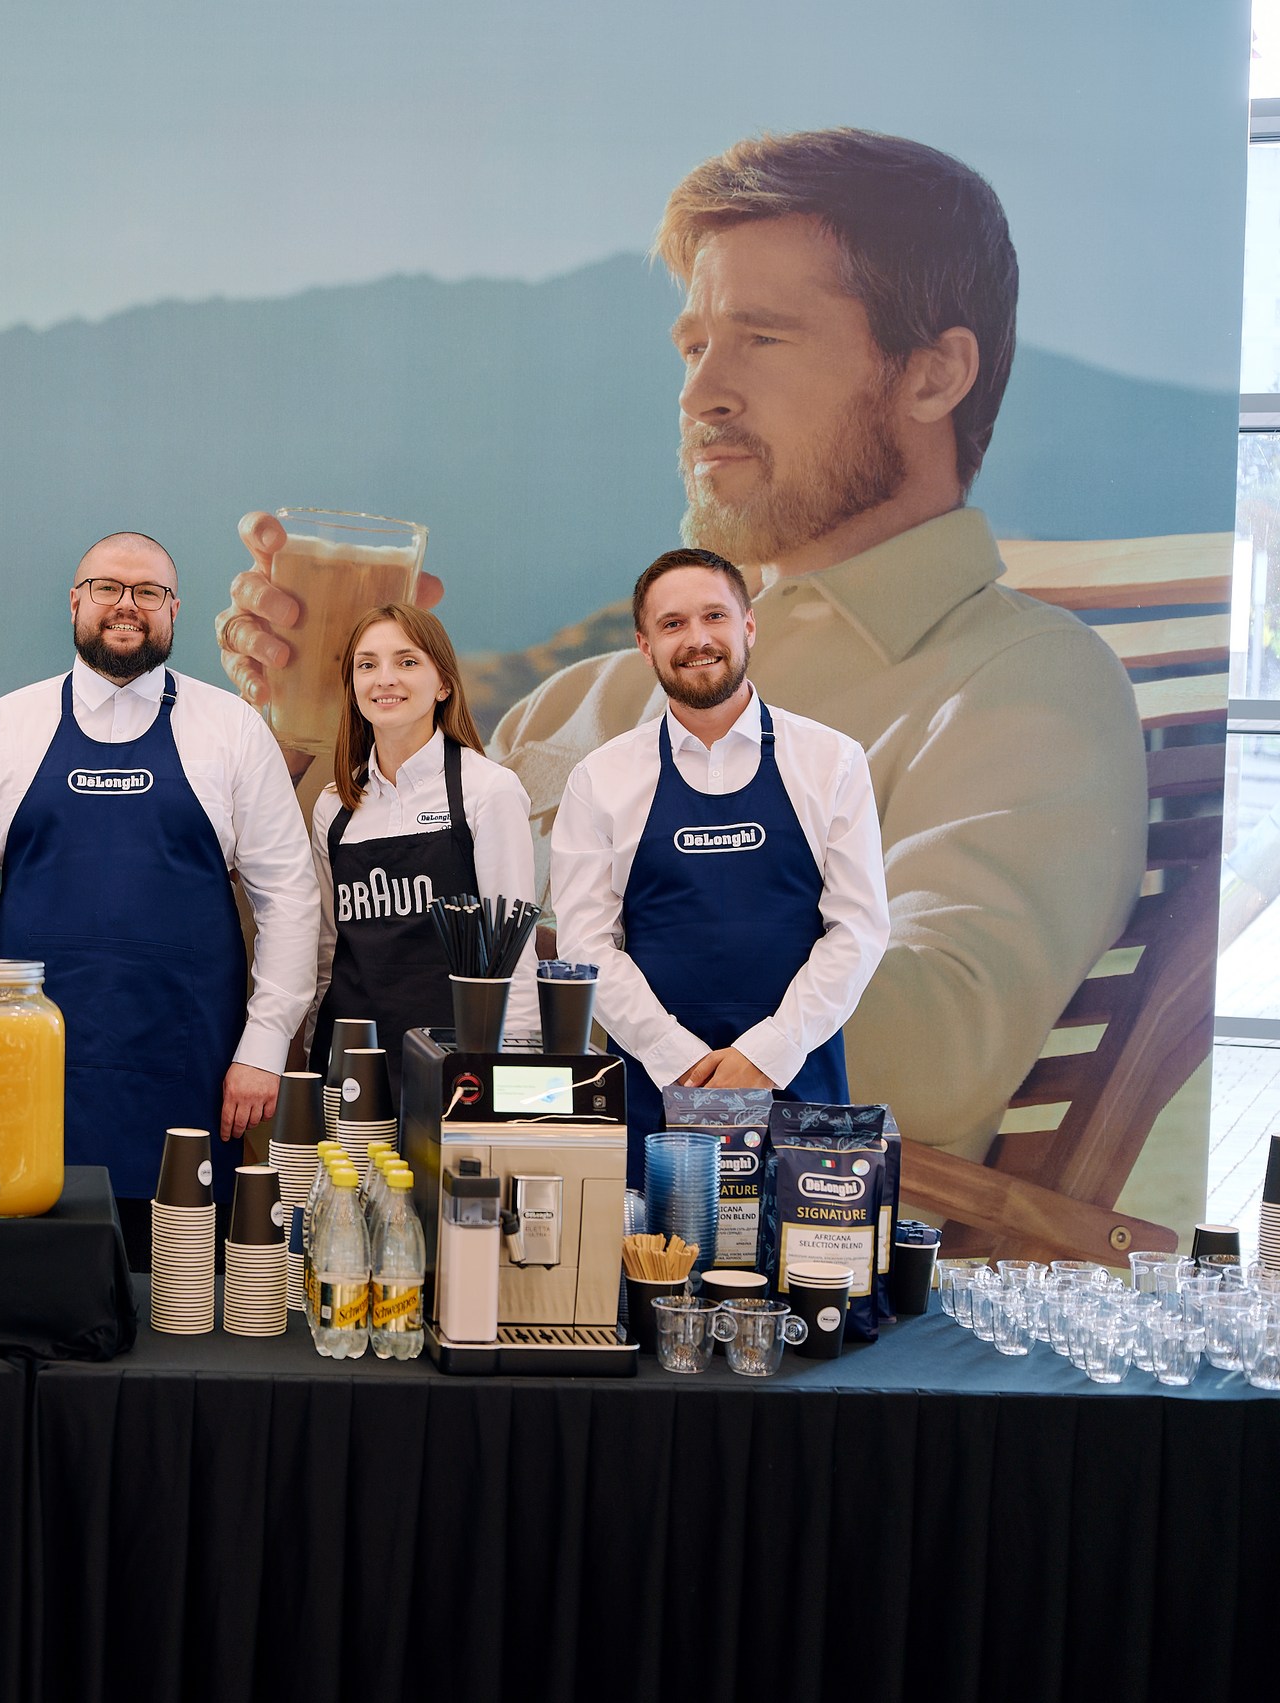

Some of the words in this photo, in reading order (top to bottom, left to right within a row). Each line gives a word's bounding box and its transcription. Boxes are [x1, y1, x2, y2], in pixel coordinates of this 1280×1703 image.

[338, 867, 433, 921] BRAUN
[720, 1157, 752, 1171] onghi
[720, 1185, 758, 1195] ATURE
[797, 1206, 866, 1220] SIGNATURE
[814, 1234, 851, 1242] AFRICANA
[799, 1240, 839, 1249] SELECTION
